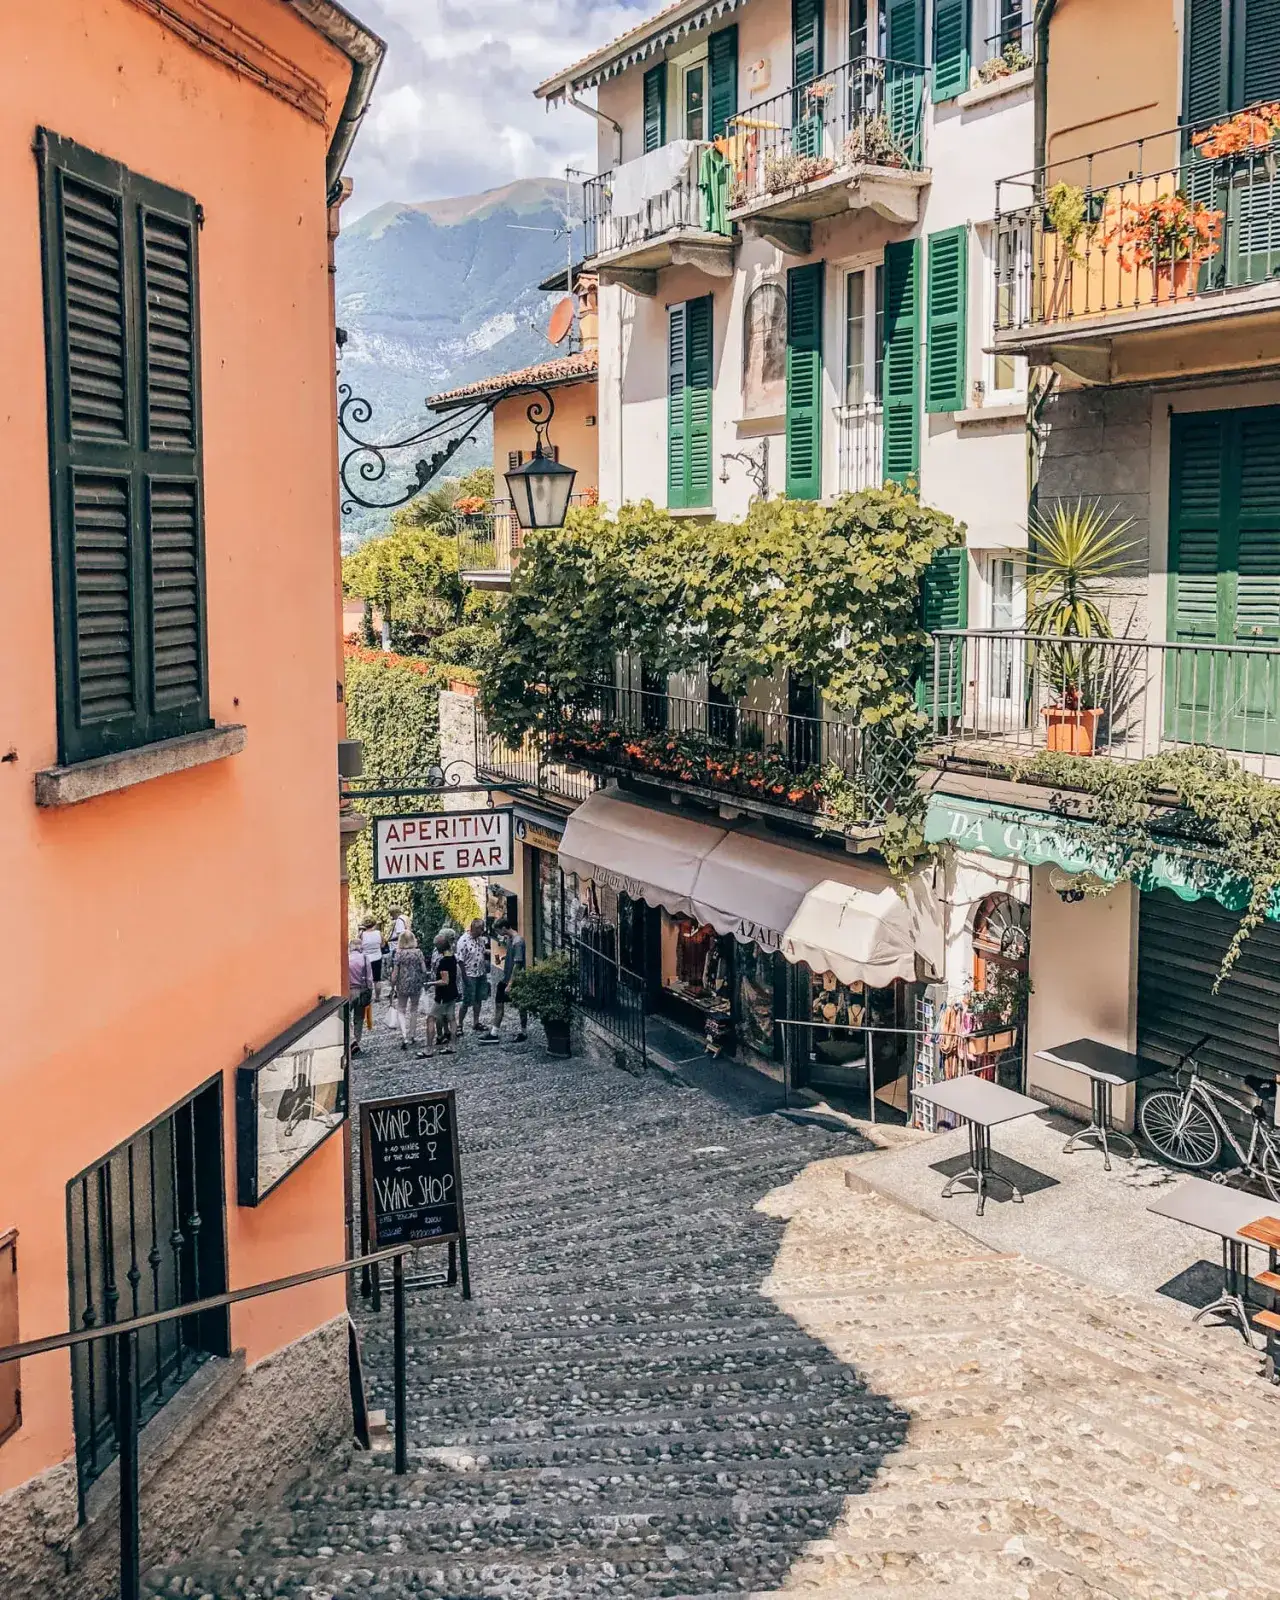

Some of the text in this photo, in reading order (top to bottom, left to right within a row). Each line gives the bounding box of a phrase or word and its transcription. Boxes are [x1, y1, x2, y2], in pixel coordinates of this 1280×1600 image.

[385, 815, 500, 843] APERITIVI
[946, 811, 984, 842] DA
[385, 846, 502, 874] WINE BAR
[593, 865, 645, 897] Italian Style
[736, 919, 796, 955] AZALEA
[418, 1173, 454, 1205] SHOP
